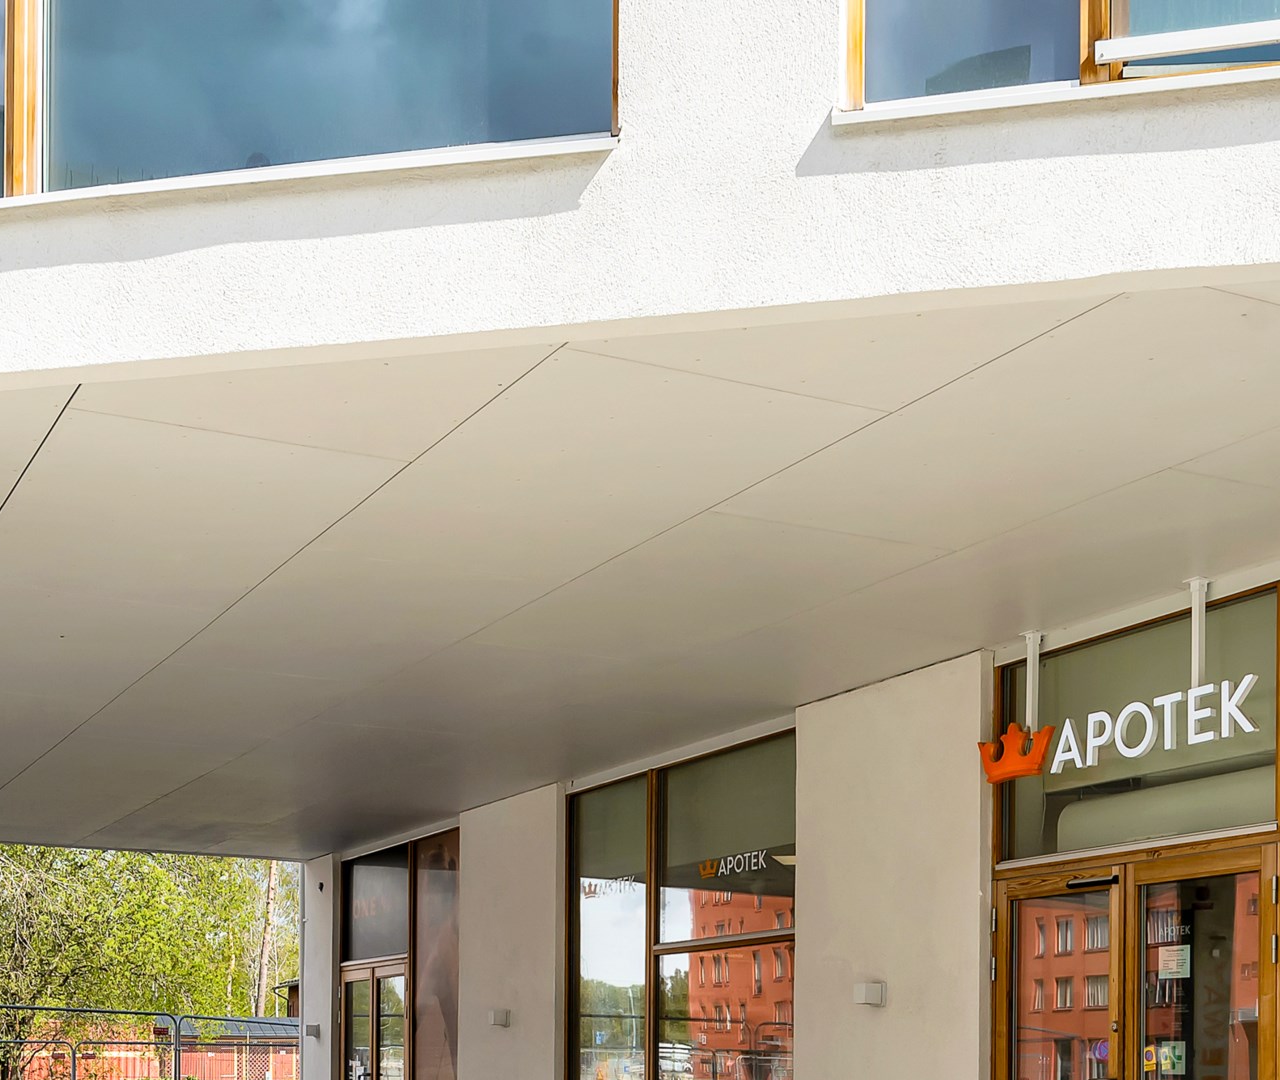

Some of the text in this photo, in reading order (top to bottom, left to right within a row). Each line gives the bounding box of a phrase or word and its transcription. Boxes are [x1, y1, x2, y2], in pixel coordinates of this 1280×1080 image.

[1050, 673, 1260, 775] APOTEK
[718, 850, 767, 877] APOTEK
[1160, 925, 1191, 936] APOTEK
